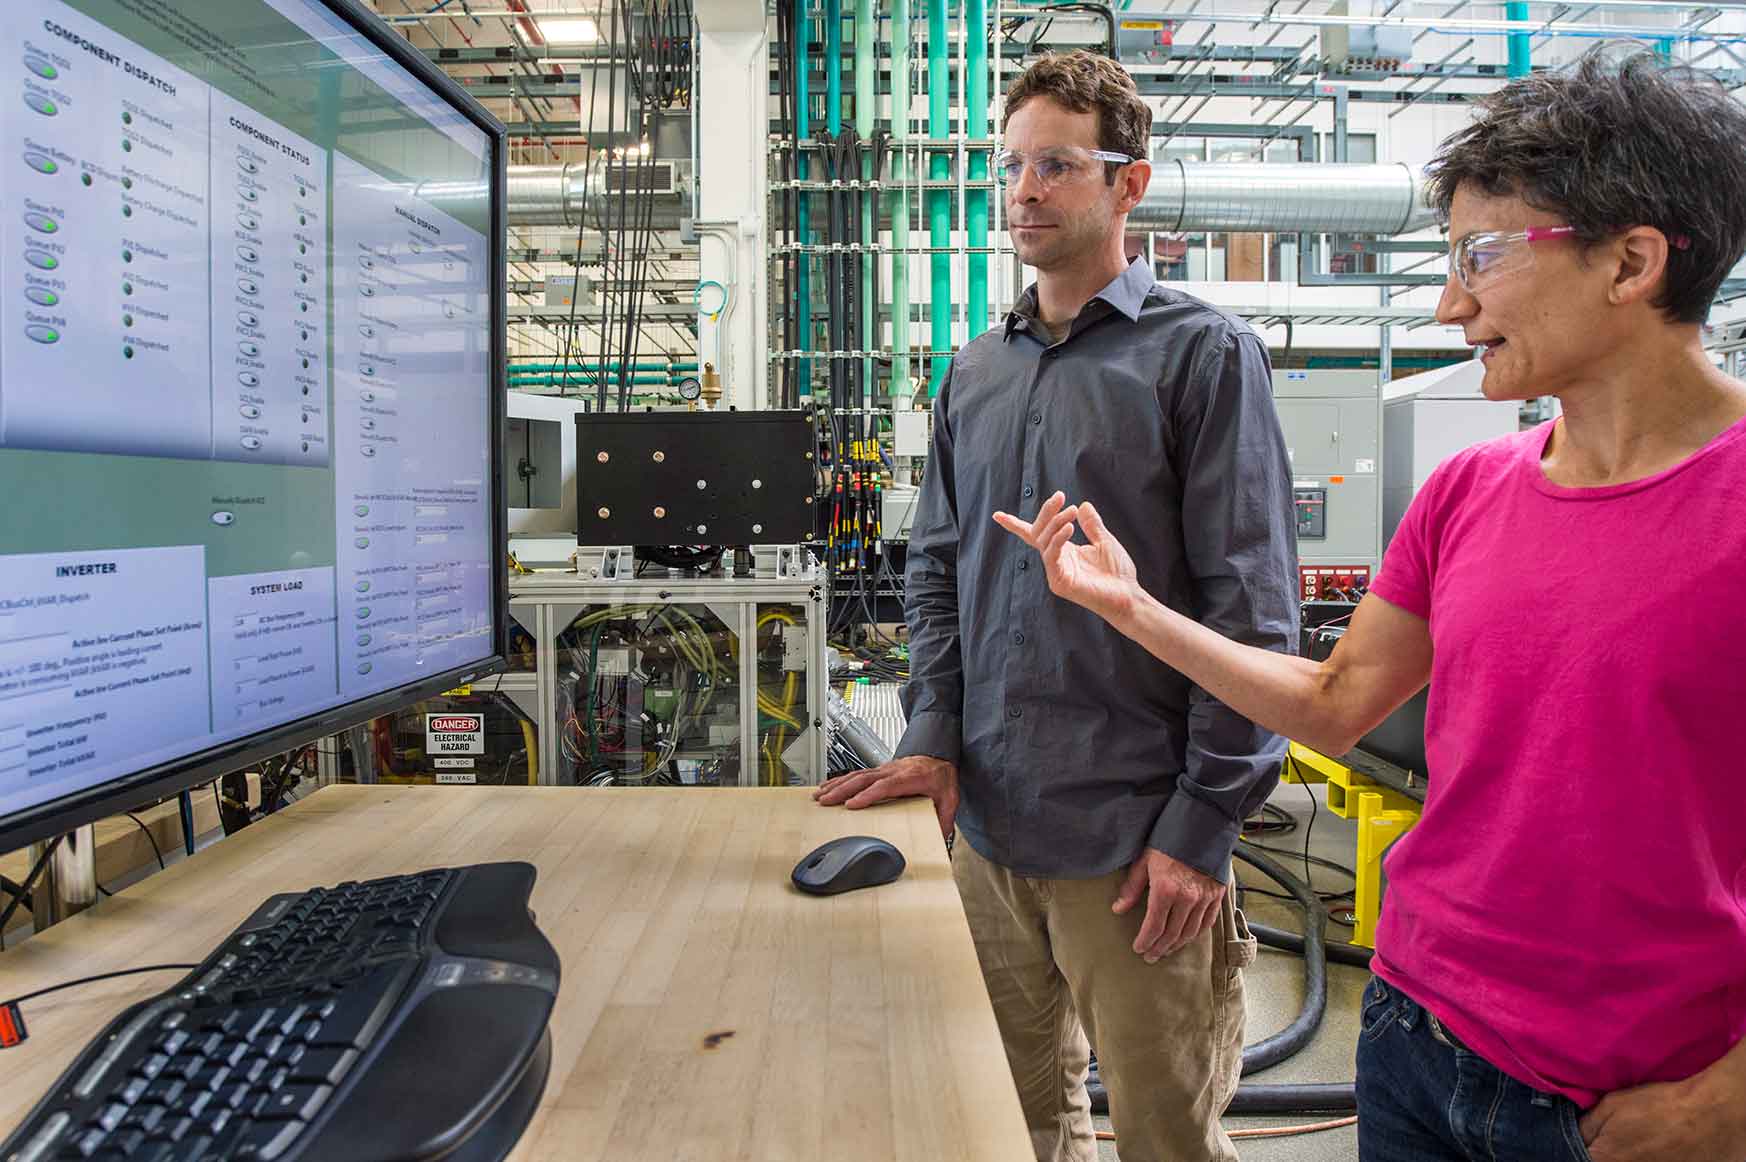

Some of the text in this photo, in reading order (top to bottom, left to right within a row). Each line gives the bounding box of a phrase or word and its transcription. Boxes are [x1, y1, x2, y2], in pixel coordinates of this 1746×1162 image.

[43, 19, 120, 68] COMPONENT
[124, 61, 177, 97] DISPATCH
[229, 116, 280, 150] COMPONENT
[281, 144, 311, 166] STATUS
[56, 562, 117, 577] INVERTER
[250, 580, 303, 595] SYSTEM LOAD
[434, 720, 476, 729] DANGER
[434, 734, 476, 742] ELECTRICAL
[440, 743, 470, 751] HAZARD
